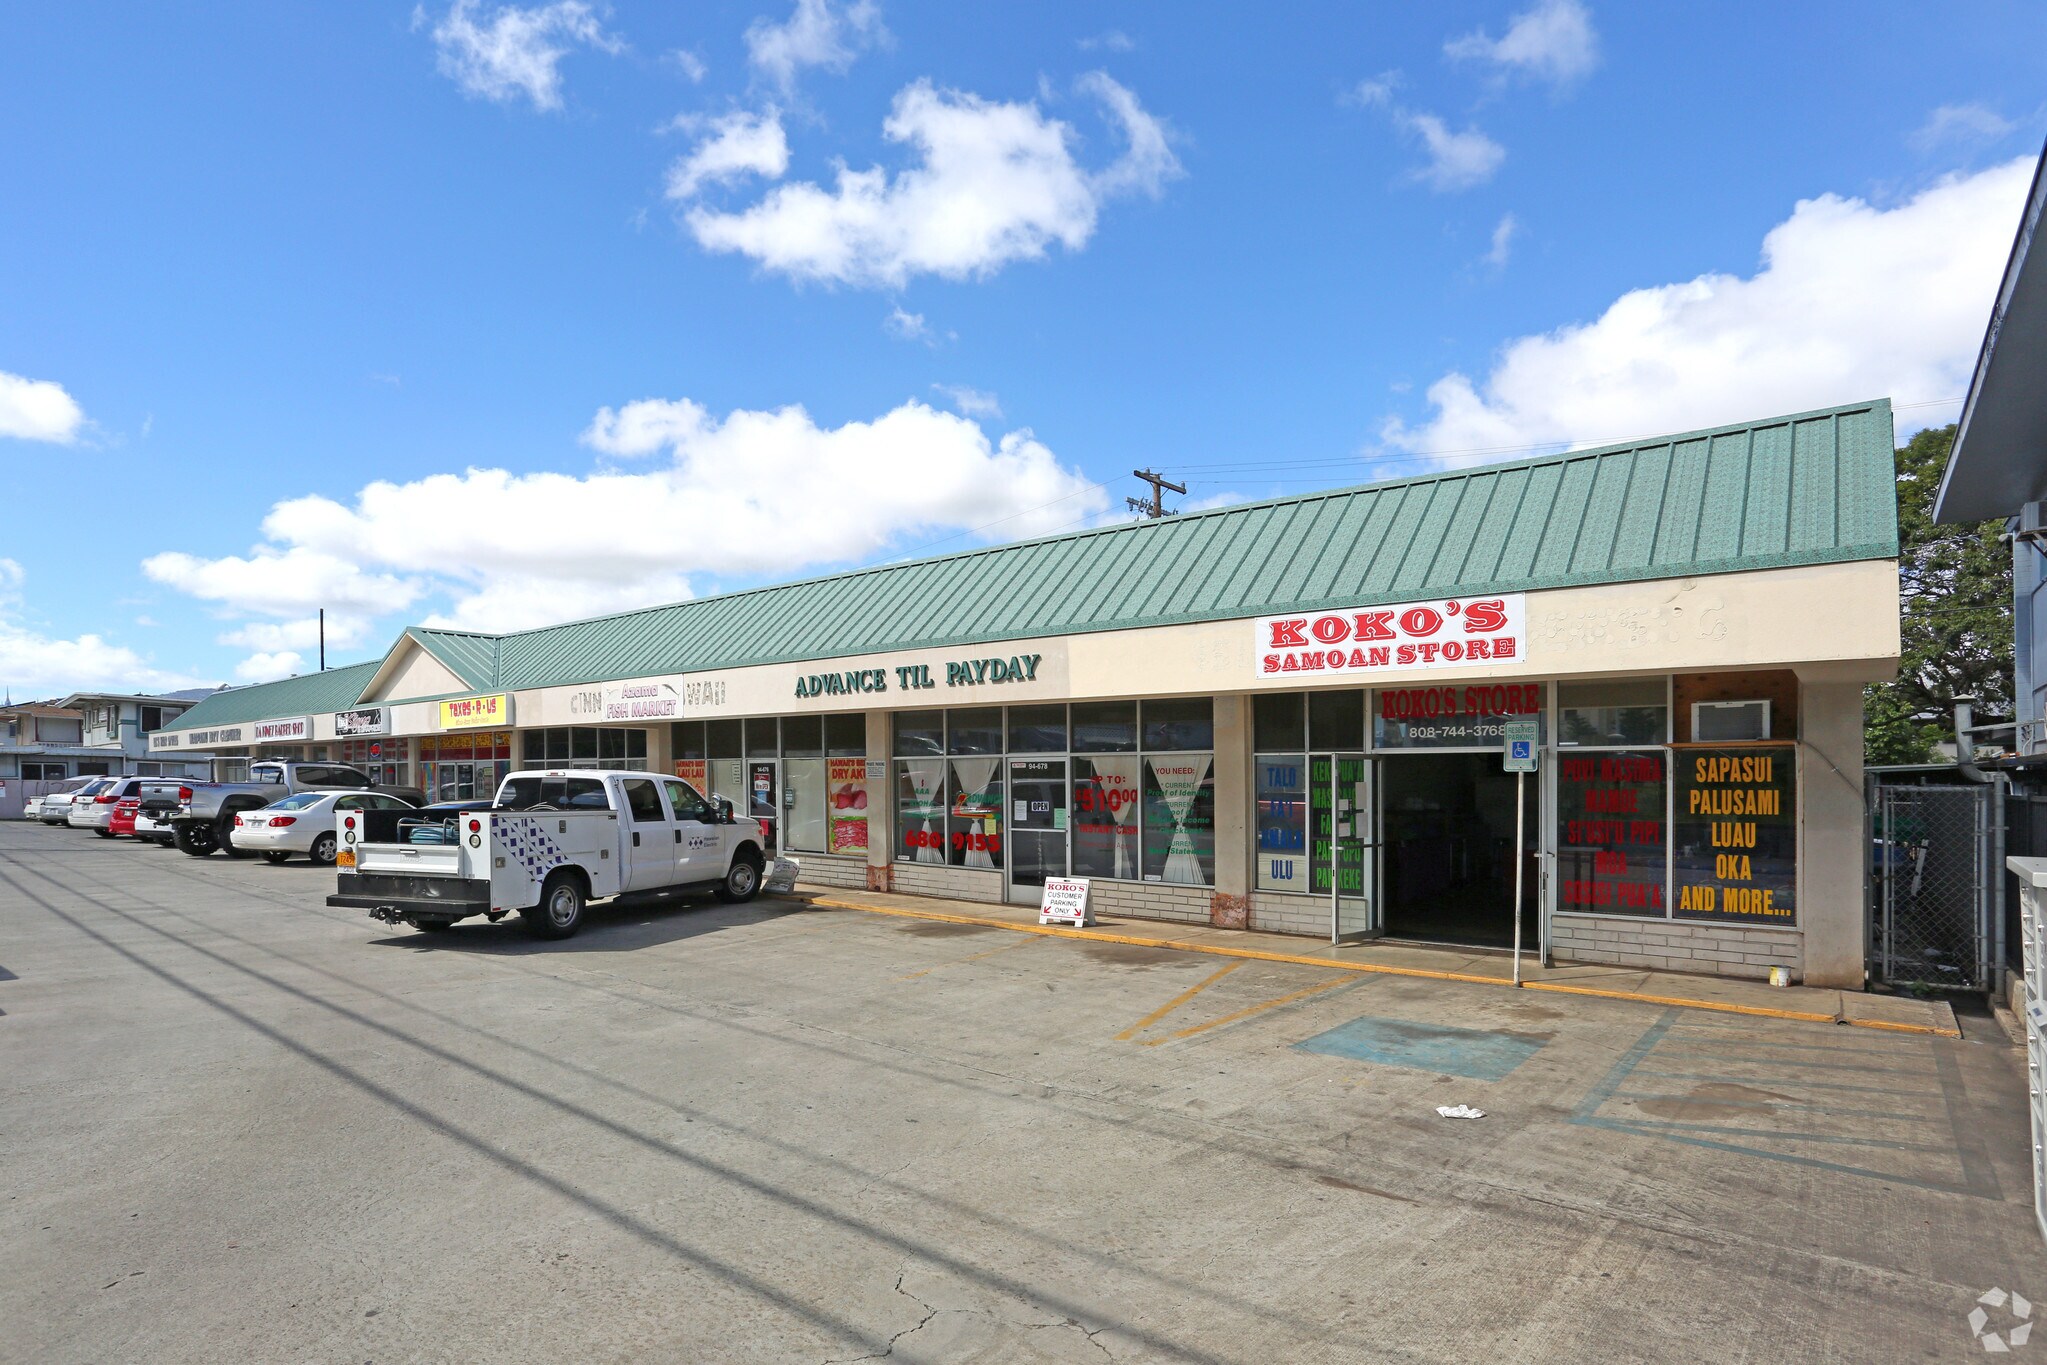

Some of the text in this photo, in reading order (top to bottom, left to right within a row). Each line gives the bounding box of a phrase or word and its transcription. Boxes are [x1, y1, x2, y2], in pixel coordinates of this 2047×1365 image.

[1268, 600, 1508, 648] KOKO'S
[1263, 636, 1516, 673] SAMOAN STORE
[794, 654, 1041, 698] ADVANCE TIL PAYDAY
[621, 684, 659, 699] Azama
[606, 699, 676, 719] FISH MARKET
[1382, 684, 1539, 719] KOKO'S STORE
[1409, 725, 1505, 738] 808-744-3768
[1508, 726, 1535, 734] RESERVED
[677, 768, 705, 778] LAU LAU
[832, 768, 849, 779] DRY
[1107, 775, 1126, 784] TO:
[1172, 767, 1195, 775] NEED:
[1267, 768, 1297, 787] TALO
[1563, 758, 1594, 782] POVI
[1696, 757, 1772, 783] SAPASUI
[1147, 788, 1168, 796] Proof
[1032, 802, 1048, 811] OPEN
[1690, 789, 1779, 815] PALUSAMI
[1116, 825, 1138, 835] CASH
[1630, 821, 1659, 845] PIPI
[1711, 822, 1756, 848] LUAU
[1271, 860, 1293, 880] ULU
[1716, 854, 1752, 880] OKA
[1047, 884, 1085, 892] KOKO'S
[1047, 892, 1083, 900] CUSTOMER
[1050, 899, 1077, 907] PARKING
[1680, 886, 1791, 916] AND MORE...
